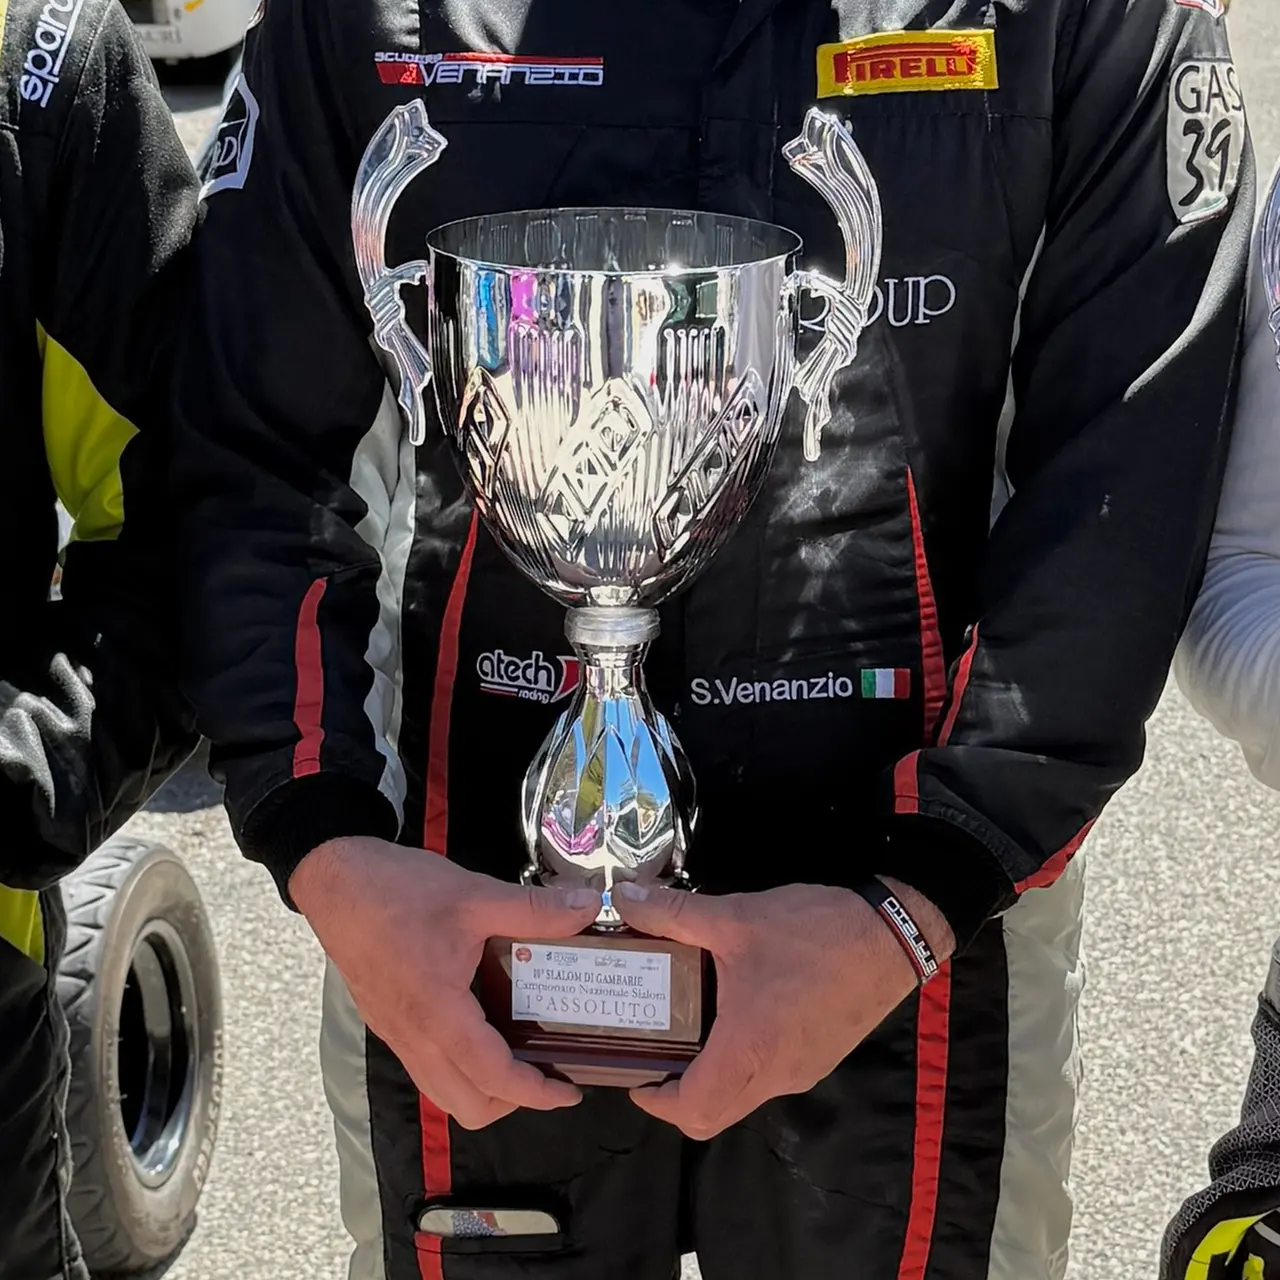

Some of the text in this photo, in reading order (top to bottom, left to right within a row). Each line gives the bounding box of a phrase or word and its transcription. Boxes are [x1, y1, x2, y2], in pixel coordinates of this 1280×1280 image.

[832, 41, 979, 86] PIRELLI
[1174, 64, 1243, 114] GAS
[476, 650, 556, 690] atech
[691, 671, 853, 706] S.Venanzio
[584, 971, 595, 983] DI
[546, 995, 657, 1019] ASSOLUTO
